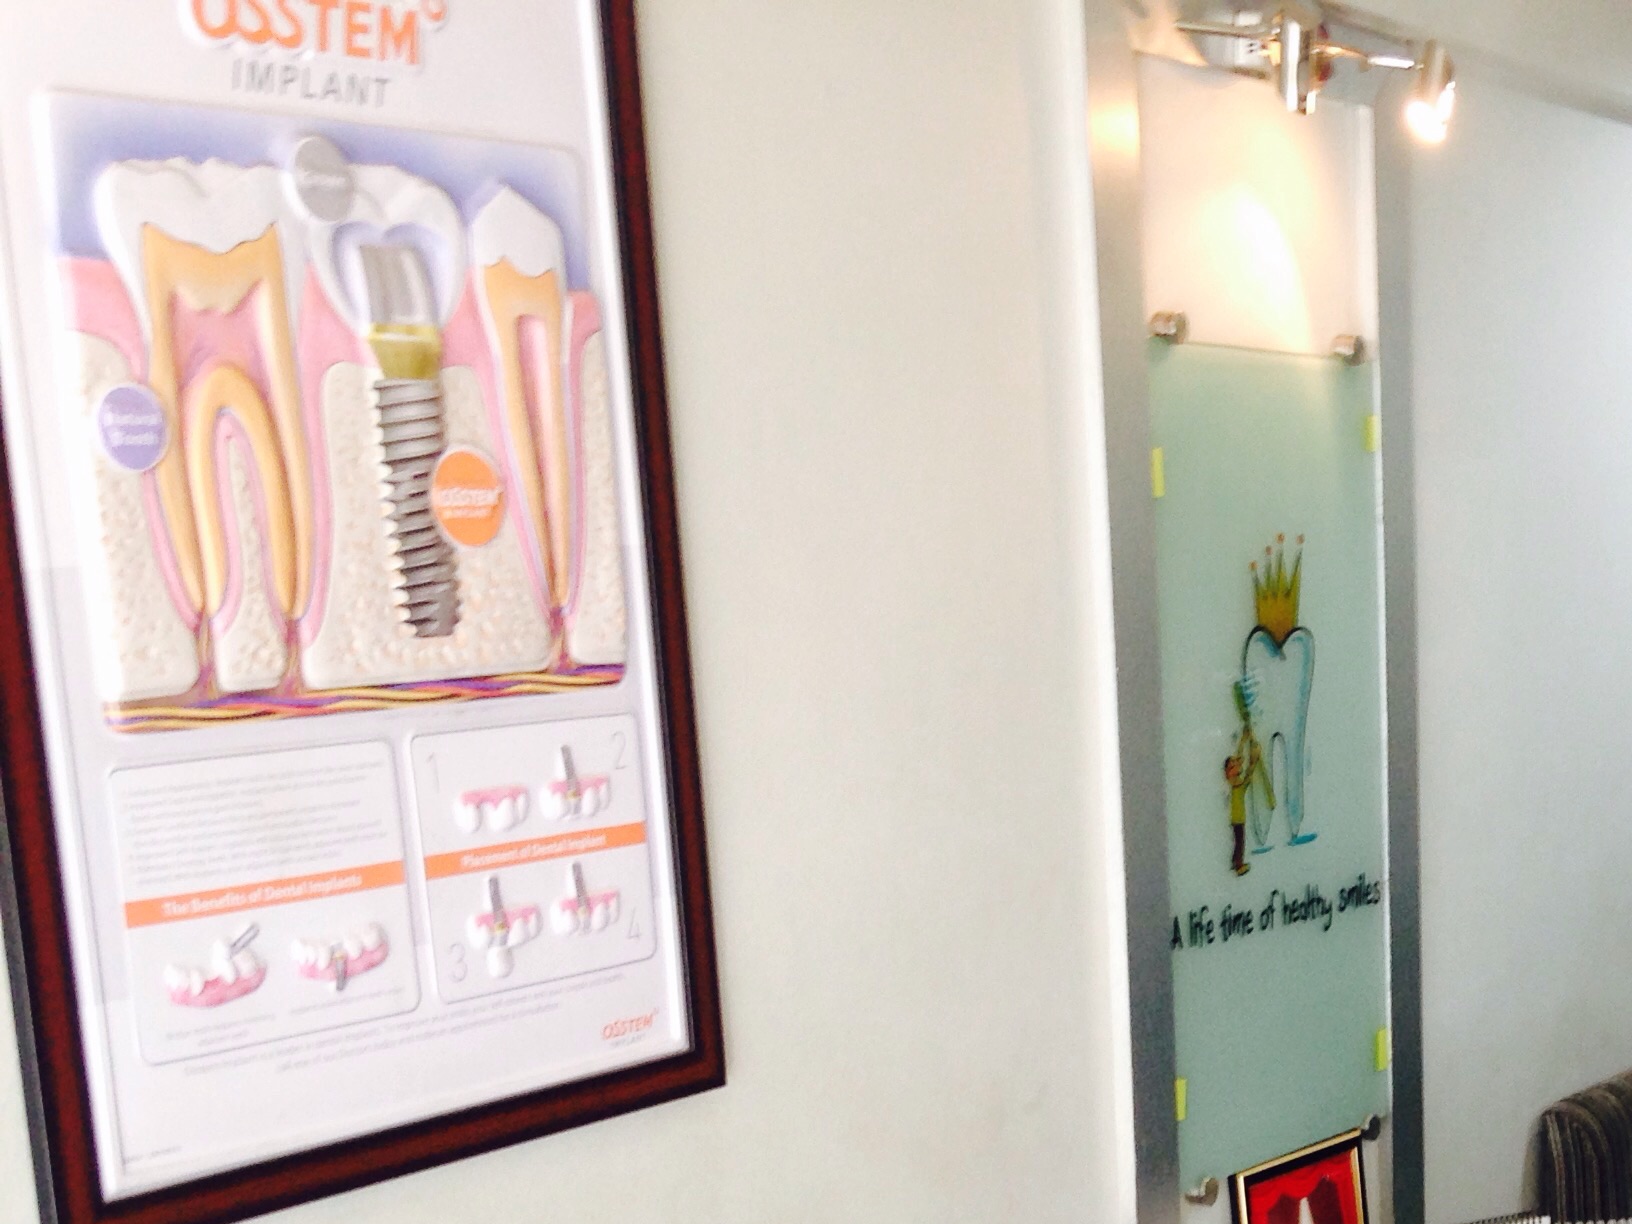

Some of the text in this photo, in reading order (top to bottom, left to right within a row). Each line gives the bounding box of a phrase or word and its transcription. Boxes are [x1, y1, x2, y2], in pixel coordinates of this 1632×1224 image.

[231, 57, 392, 108] IMPLANT
[1171, 872, 1380, 949] A life time of healthy smiles
[449, 942, 468, 983] 3
